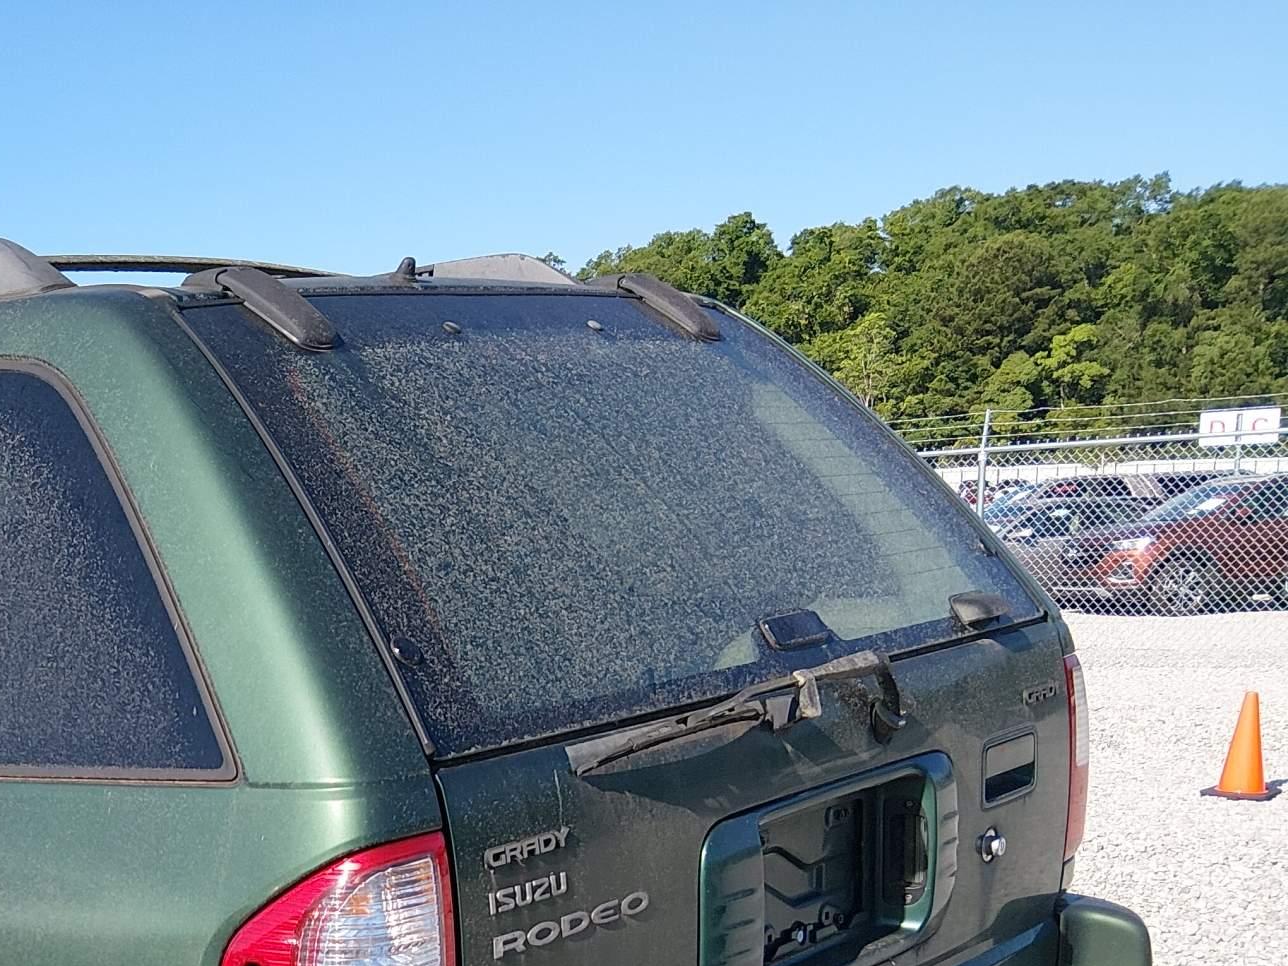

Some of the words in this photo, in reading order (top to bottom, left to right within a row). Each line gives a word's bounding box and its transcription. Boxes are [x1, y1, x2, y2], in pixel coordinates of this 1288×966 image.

[484, 826, 571, 869] GRADY
[488, 871, 568, 916] ISUZU
[493, 891, 650, 960] RODEO
